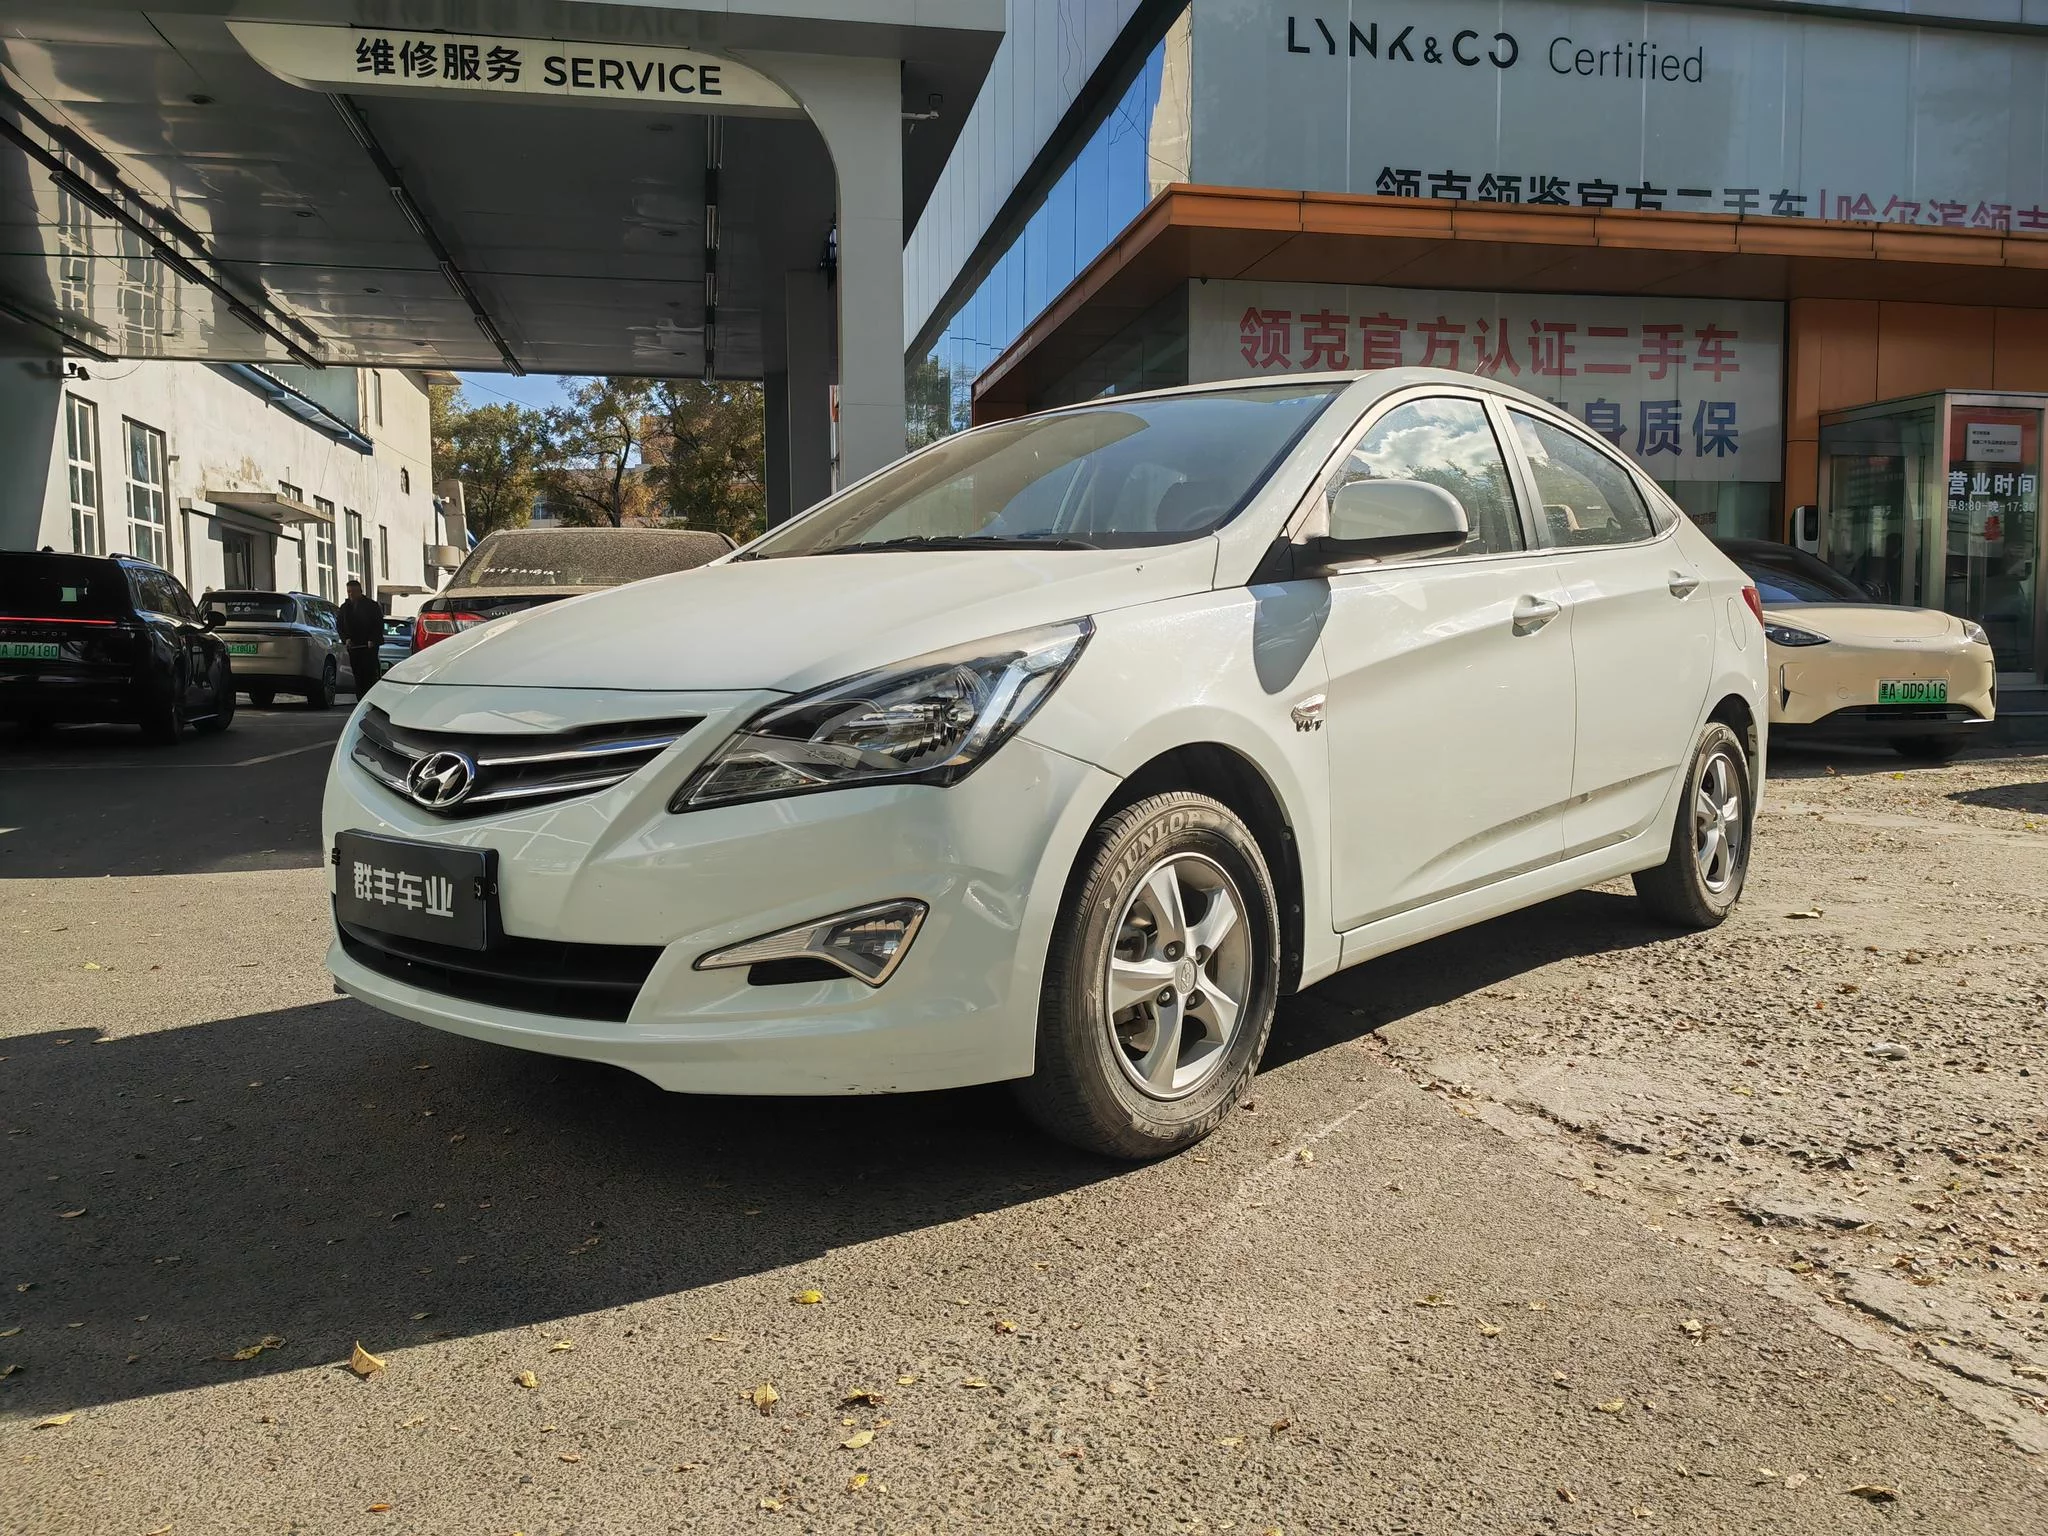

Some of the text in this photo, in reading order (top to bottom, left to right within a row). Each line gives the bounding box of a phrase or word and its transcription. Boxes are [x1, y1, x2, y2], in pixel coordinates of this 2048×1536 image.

[355, 37, 723, 95] 维修服务 SERVICE
[1549, 37, 1703, 82] Certified
[1239, 306, 1740, 382] 领克官方认证二手车
[1547, 397, 1740, 457] 身质保
[1948, 471, 2036, 497] 营业时间
[15, 645, 58, 657] DD4180
[1902, 683, 1946, 699] DD9116
[1111, 811, 1200, 893] DUNLOP
[353, 861, 454, 918] 群丰车业
